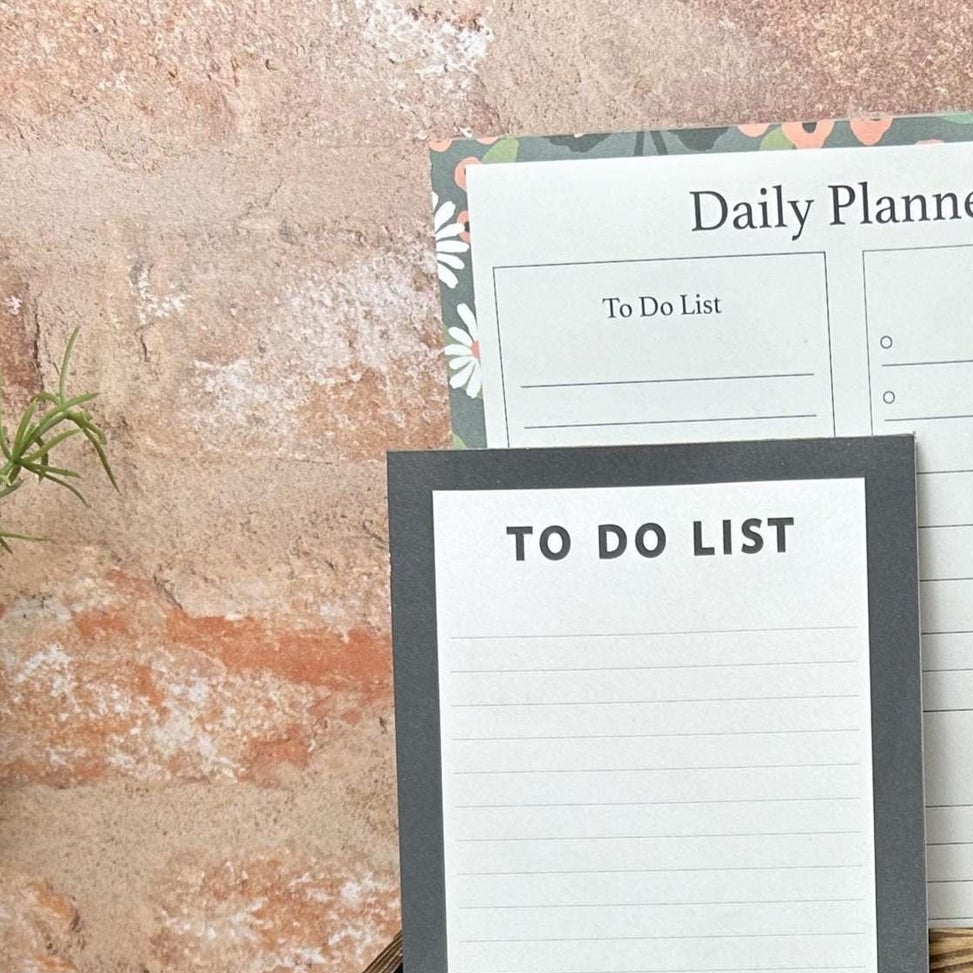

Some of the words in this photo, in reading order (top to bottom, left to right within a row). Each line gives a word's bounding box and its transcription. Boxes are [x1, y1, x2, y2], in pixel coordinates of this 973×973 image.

[689, 184, 815, 241] Daily
[602, 297, 633, 319] To
[638, 296, 674, 317] Do
[679, 293, 721, 315] List
[505, 524, 571, 562] TO
[597, 522, 667, 560] DO
[692, 516, 795, 557] LIST
